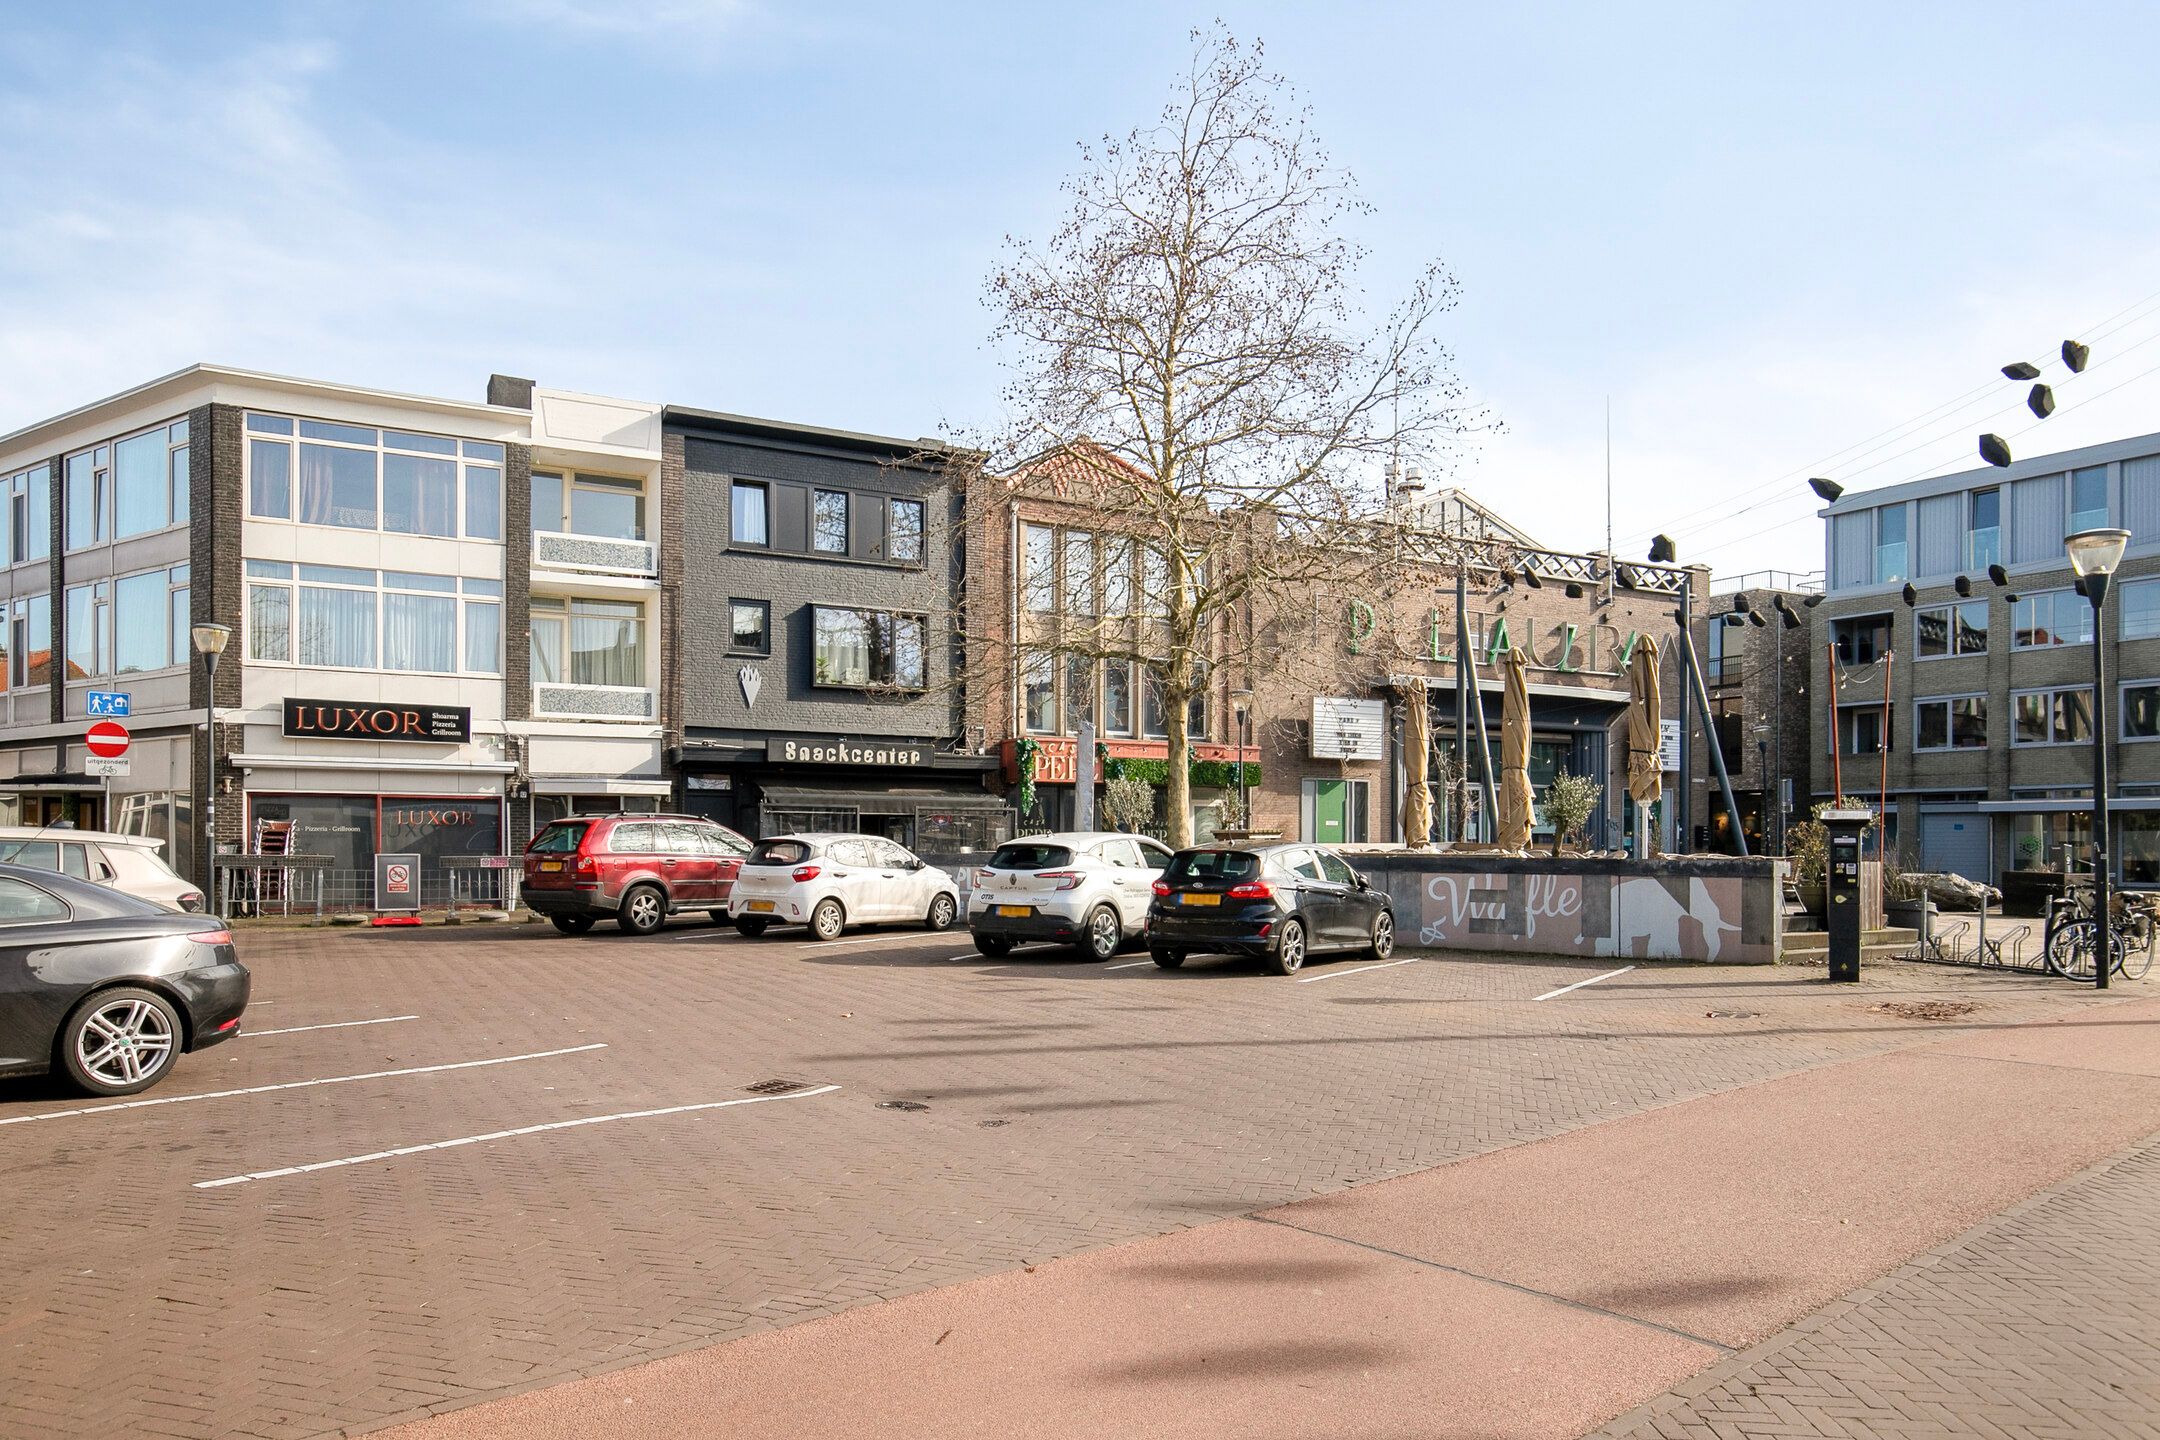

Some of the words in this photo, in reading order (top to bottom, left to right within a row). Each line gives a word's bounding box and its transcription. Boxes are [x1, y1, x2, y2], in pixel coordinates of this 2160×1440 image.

[296, 706, 428, 735] LUXOR
[432, 712, 459, 720] Shoarma
[432, 720, 456, 728] Pizzeria
[785, 741, 920, 765] Snackcenter
[1048, 741, 1077, 754] CAS
[1034, 754, 1098, 780] PE
[397, 810, 476, 826] LUXOR
